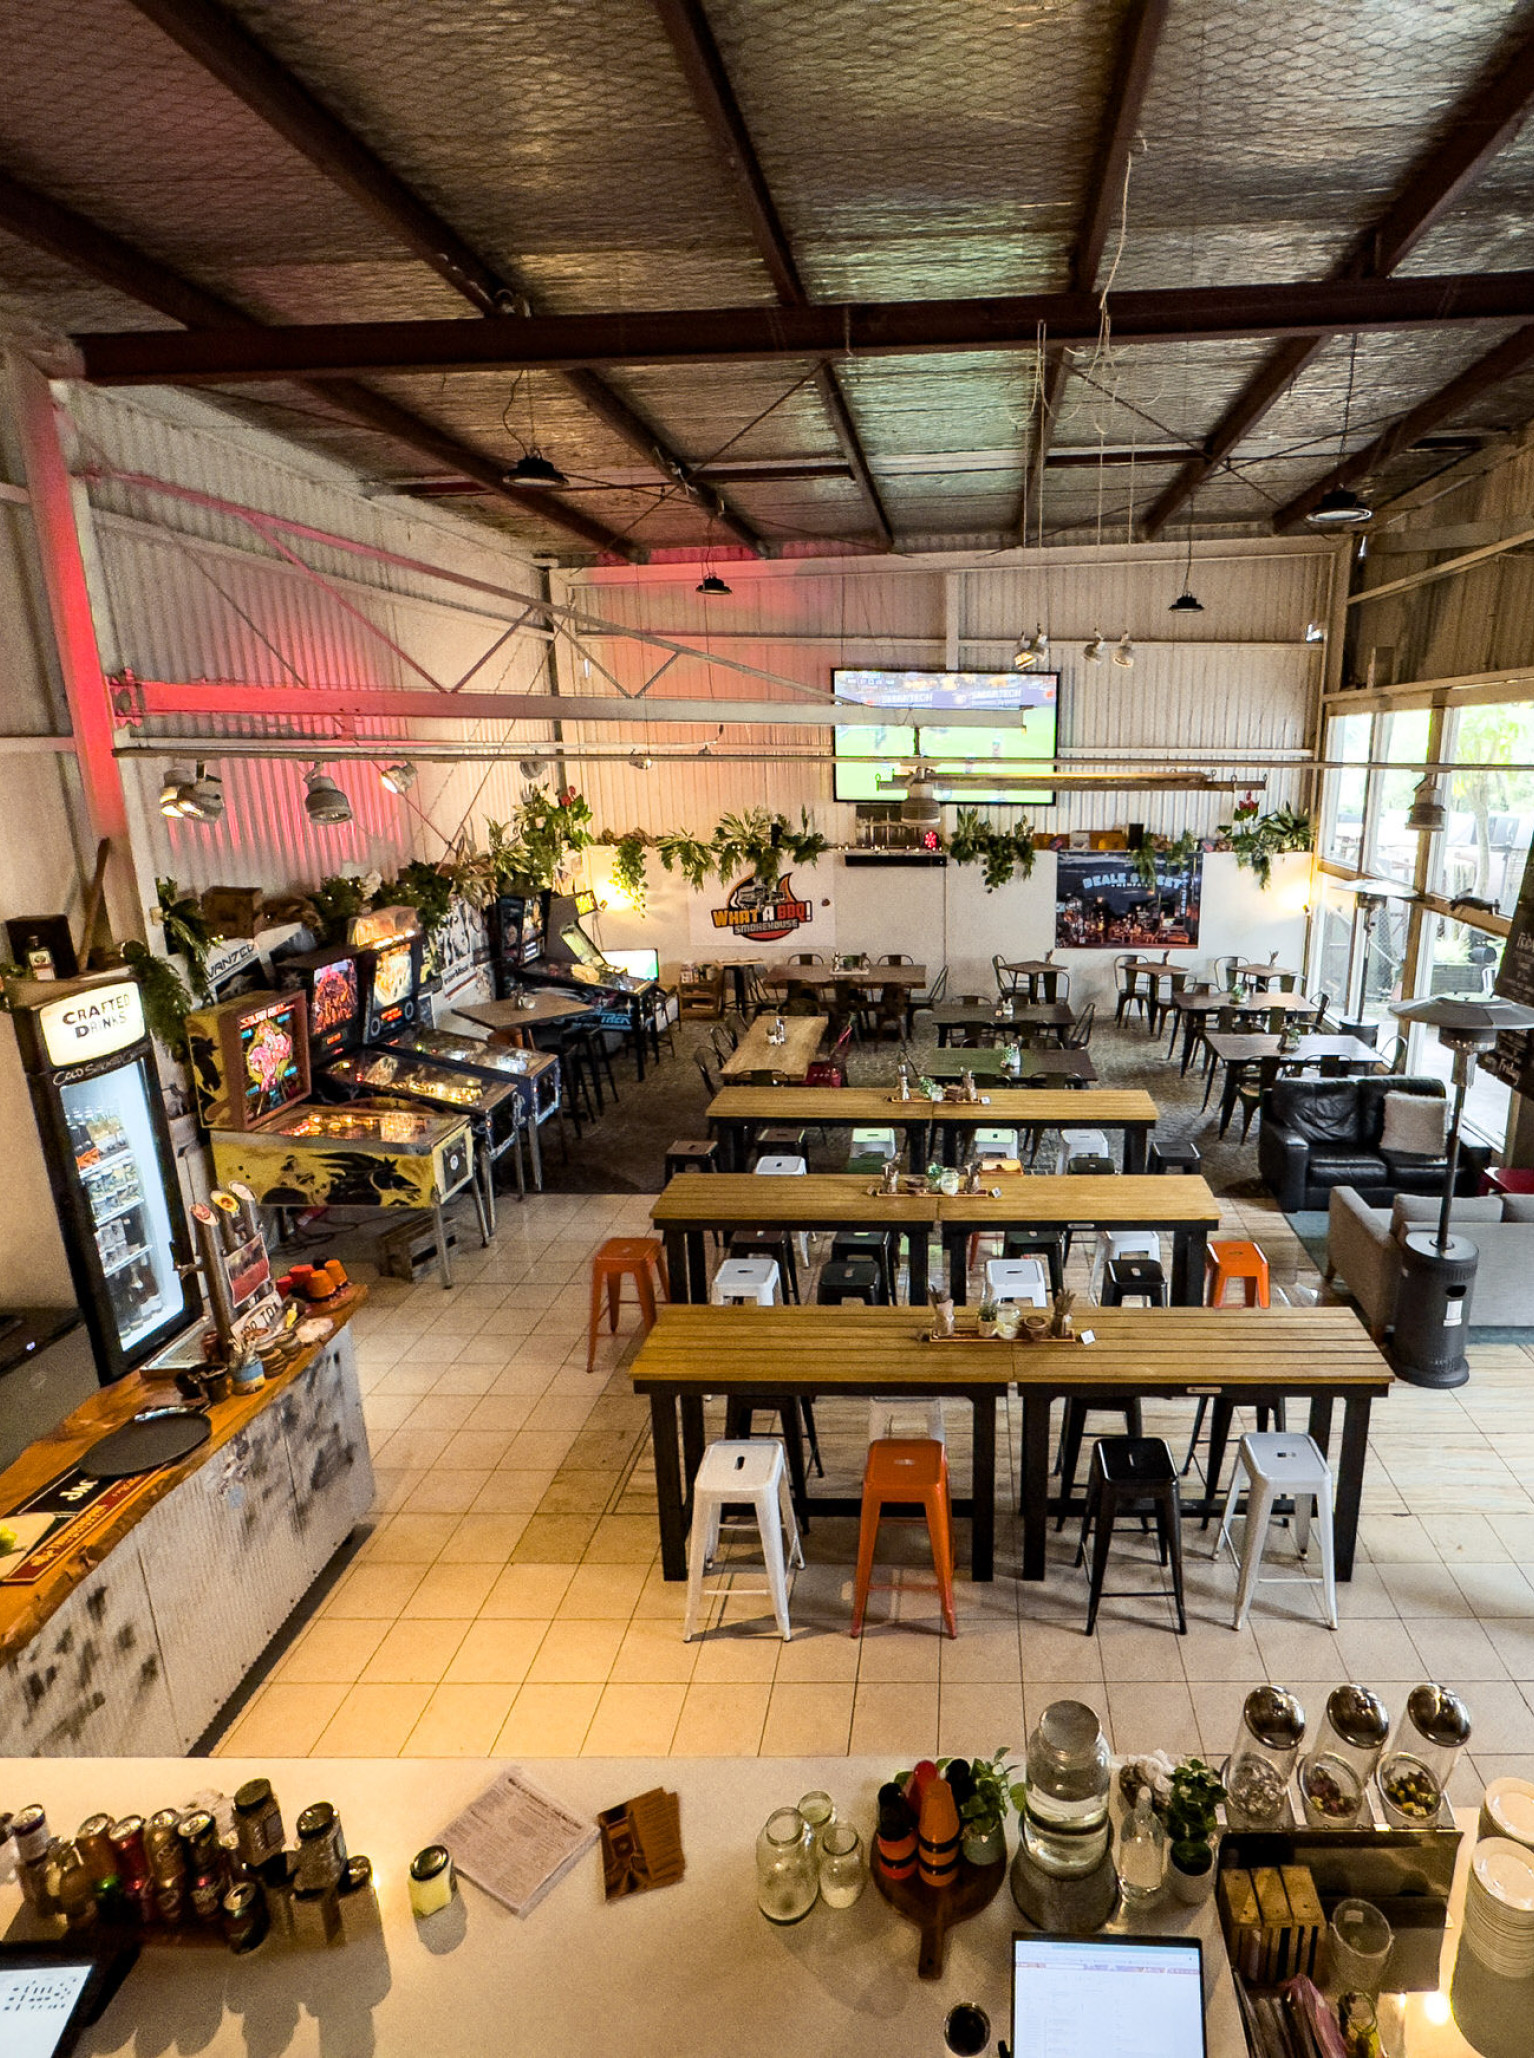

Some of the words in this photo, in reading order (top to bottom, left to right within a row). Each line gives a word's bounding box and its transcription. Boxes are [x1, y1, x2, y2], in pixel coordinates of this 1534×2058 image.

[1130, 872, 1181, 889] SEET
[712, 907, 759, 927] WHAT
[762, 904, 775, 921] A
[777, 901, 812, 922] BBQ!
[61, 993, 131, 1025] CRAFTED
[74, 1013, 128, 1039] DRINKS
